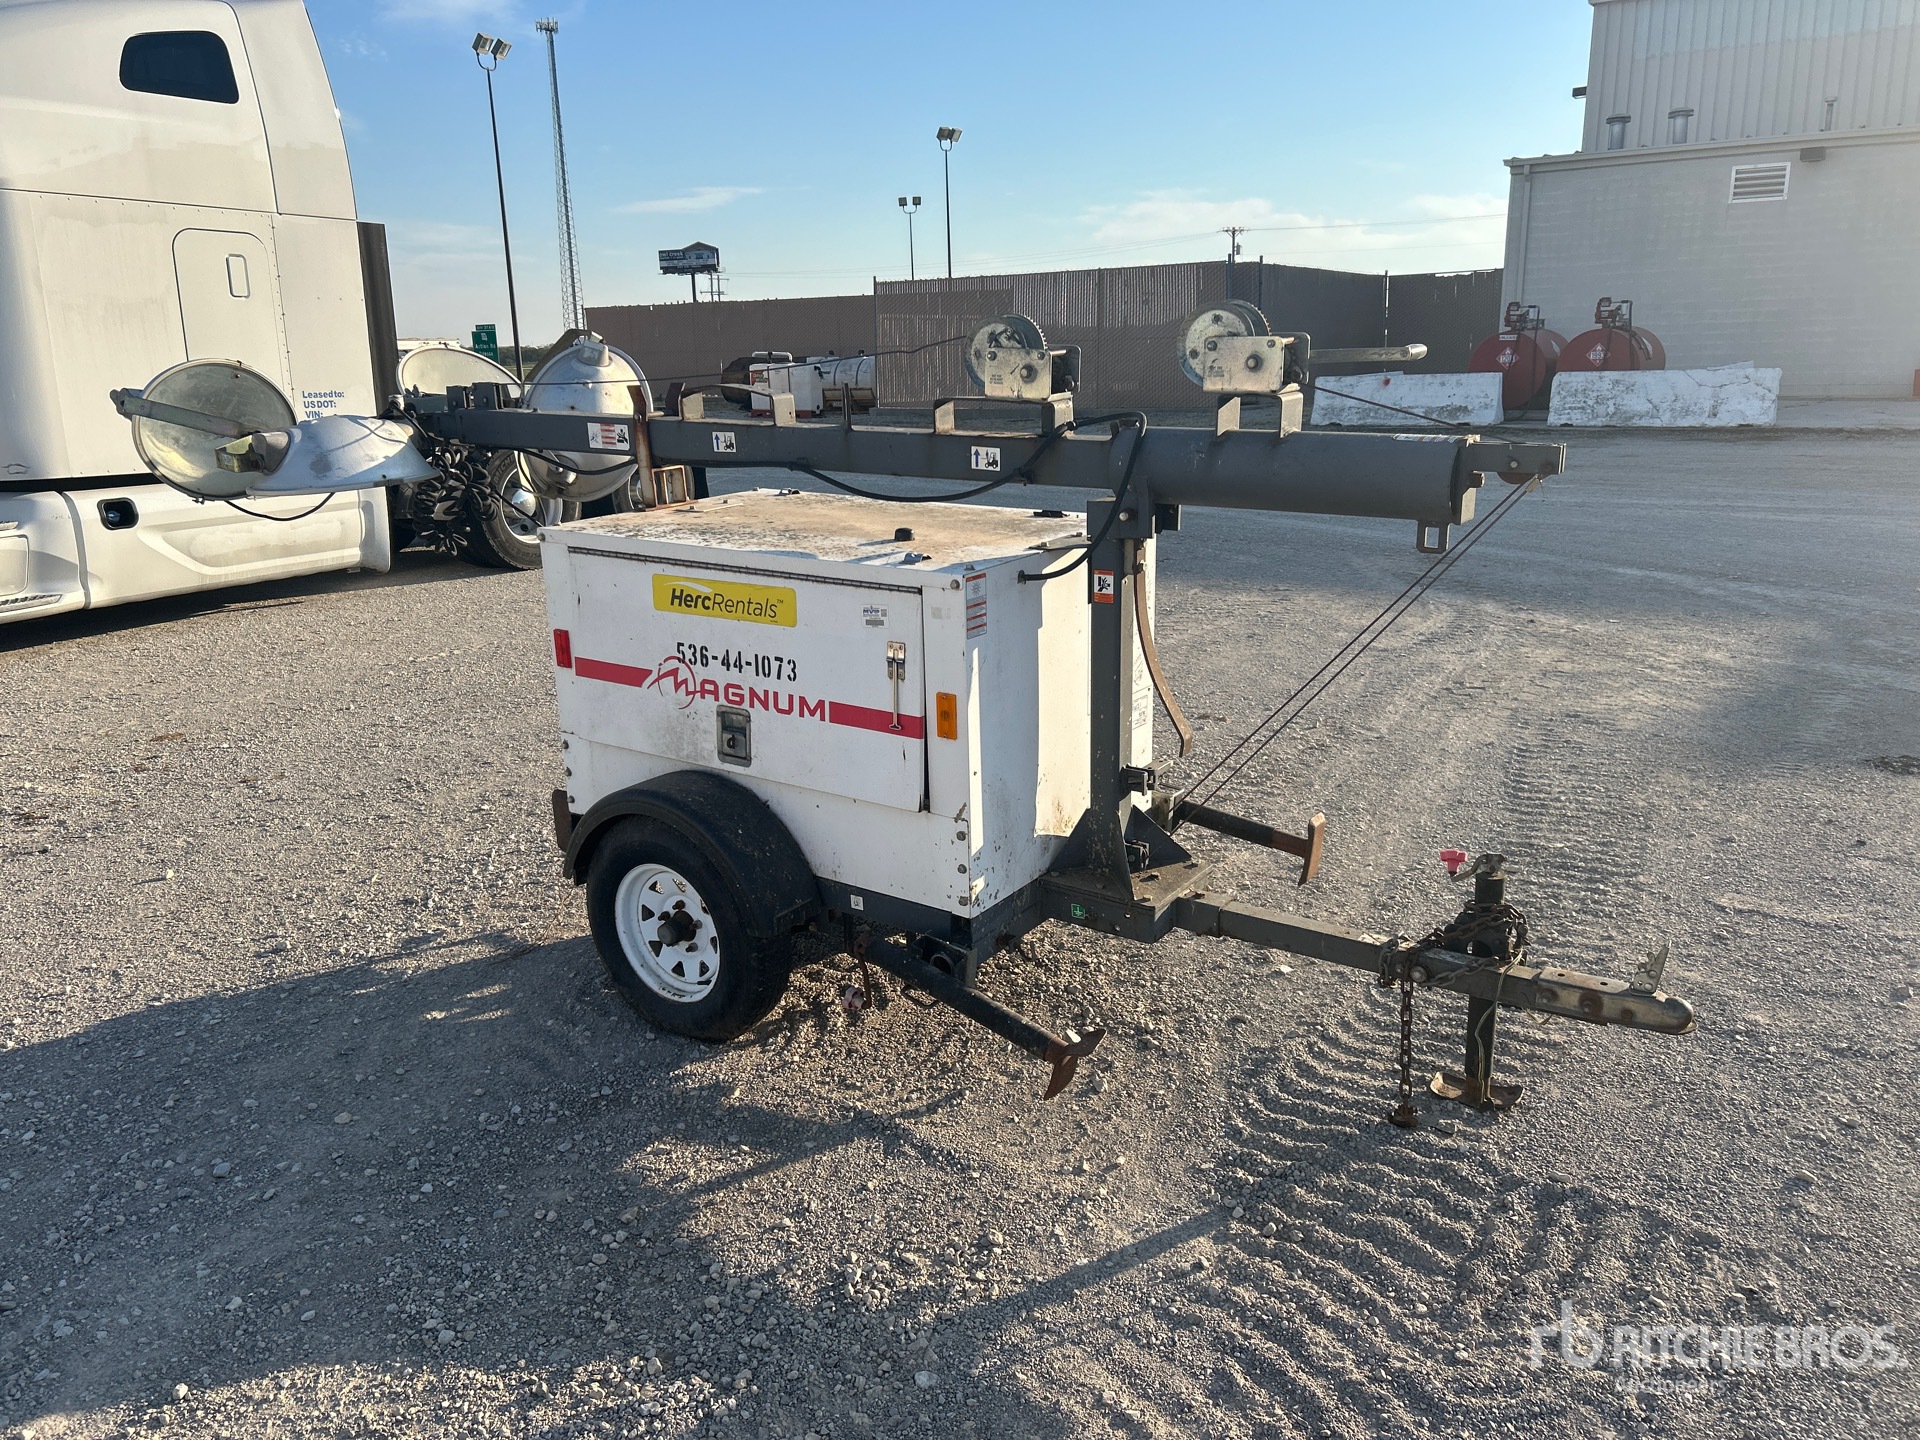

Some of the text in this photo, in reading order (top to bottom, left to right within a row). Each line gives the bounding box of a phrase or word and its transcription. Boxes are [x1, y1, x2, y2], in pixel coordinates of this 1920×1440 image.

[302, 390, 345, 399] Leased to:
[305, 410, 323, 419] VIN:
[676, 641, 798, 682] 536-44-1073
[647, 664, 826, 722] MAGNUM
